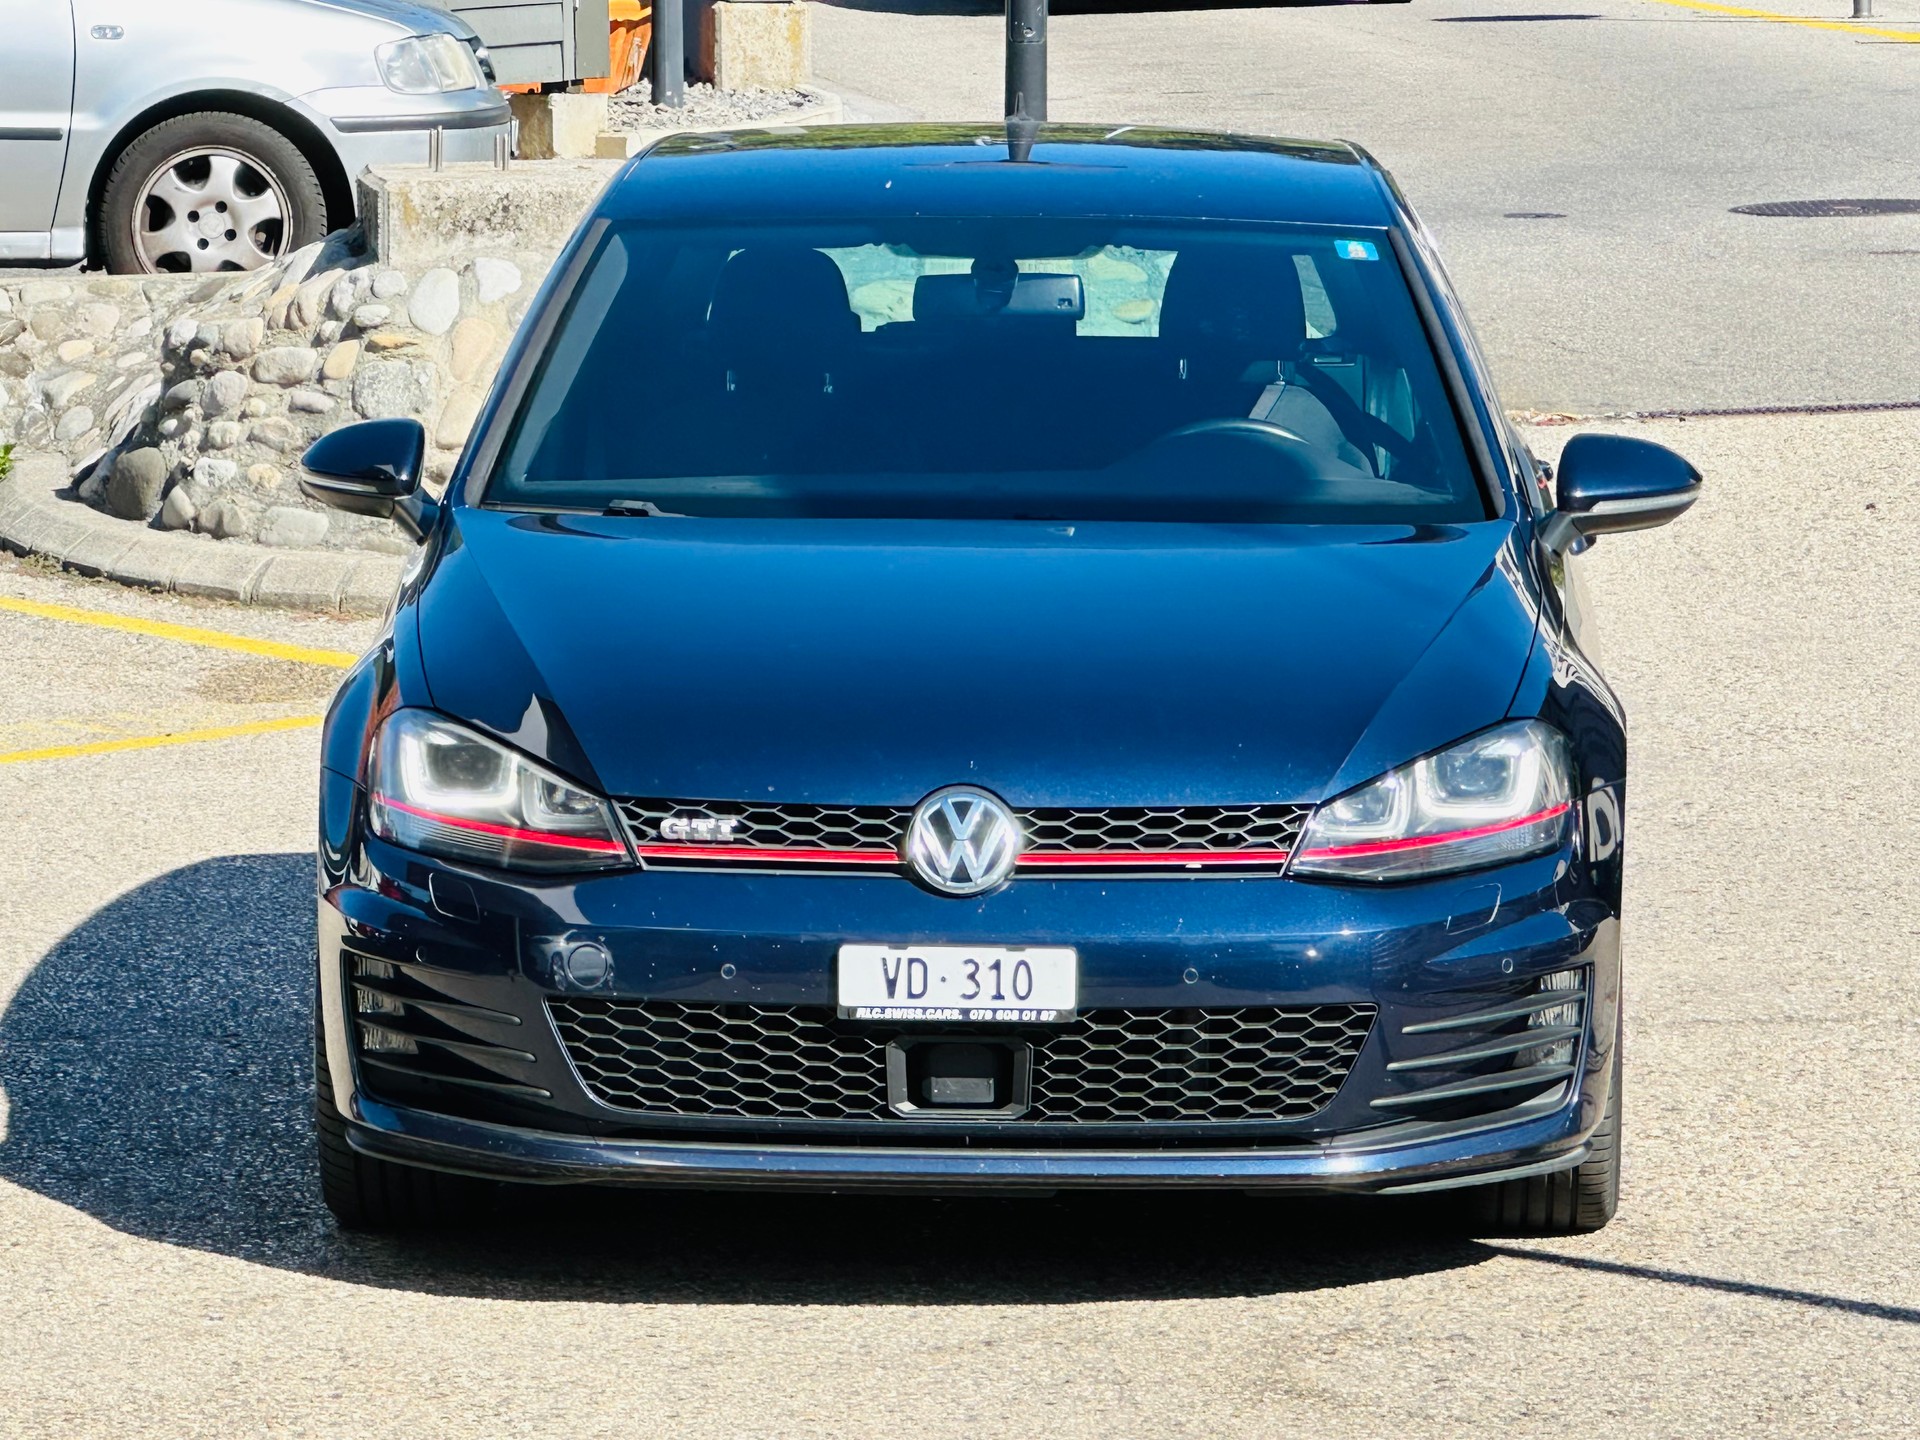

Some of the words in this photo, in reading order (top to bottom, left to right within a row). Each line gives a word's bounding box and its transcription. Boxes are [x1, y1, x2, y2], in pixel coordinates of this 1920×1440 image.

[660, 816, 738, 841] GTI
[914, 791, 1010, 889] VW
[881, 957, 928, 1000] VD
[960, 958, 1033, 1001] 310
[1022, 1010, 1037, 1021] 01
